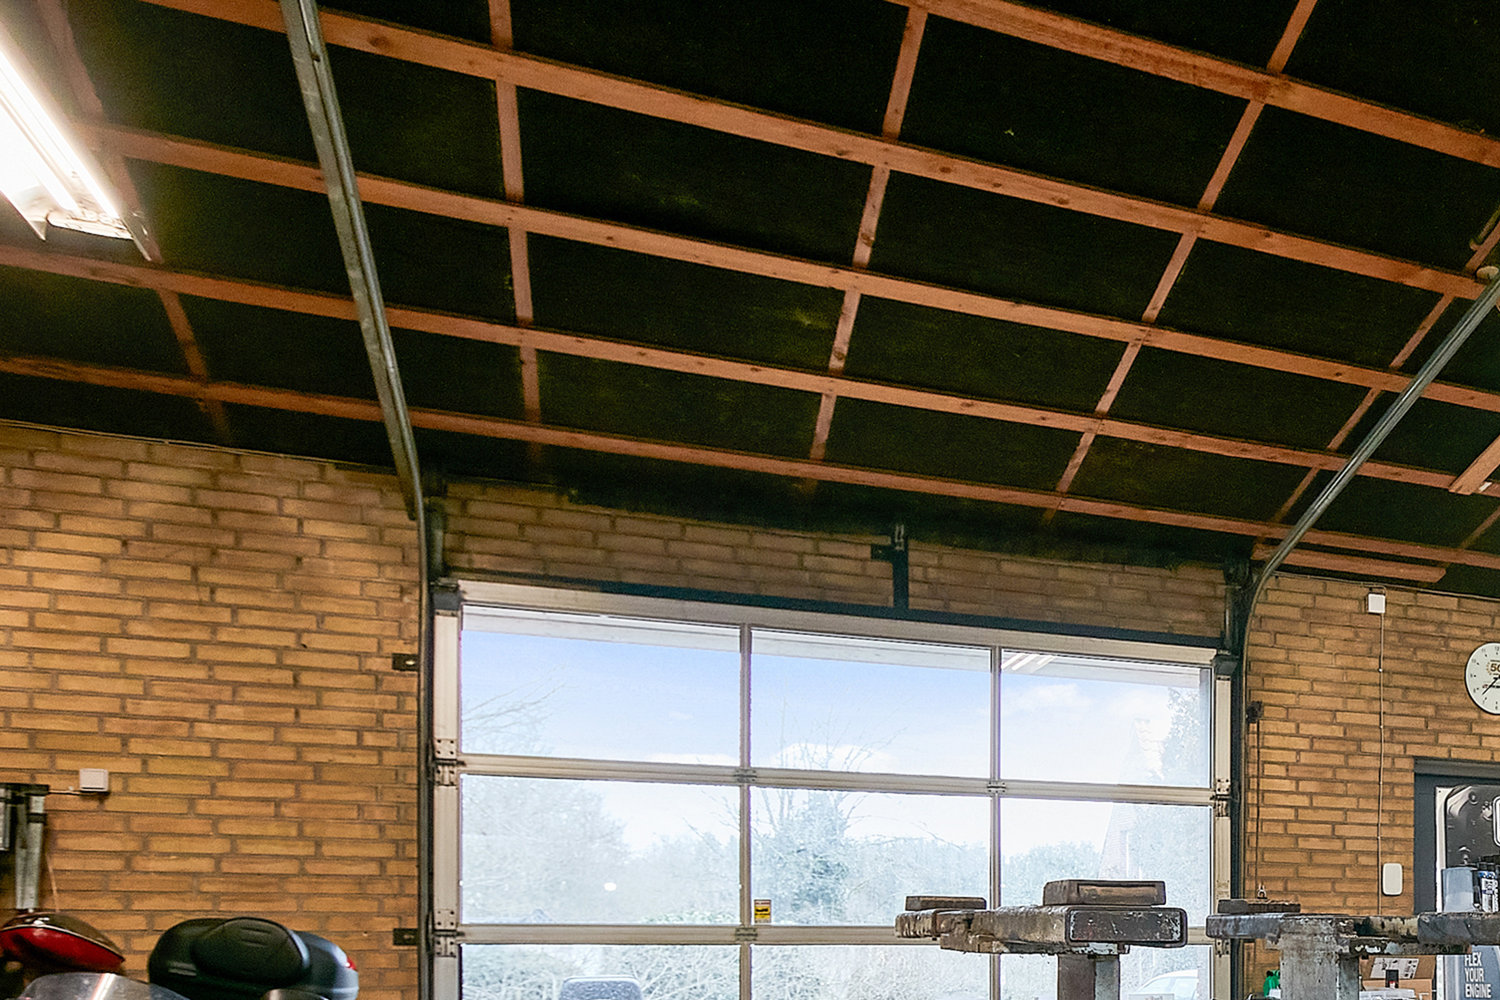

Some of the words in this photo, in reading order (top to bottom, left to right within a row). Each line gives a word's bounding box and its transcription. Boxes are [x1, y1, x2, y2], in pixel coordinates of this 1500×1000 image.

[1464, 952, 1482, 966] FLEX
[1465, 968, 1484, 982] YOUR
[1466, 984, 1492, 998] ENGINE
